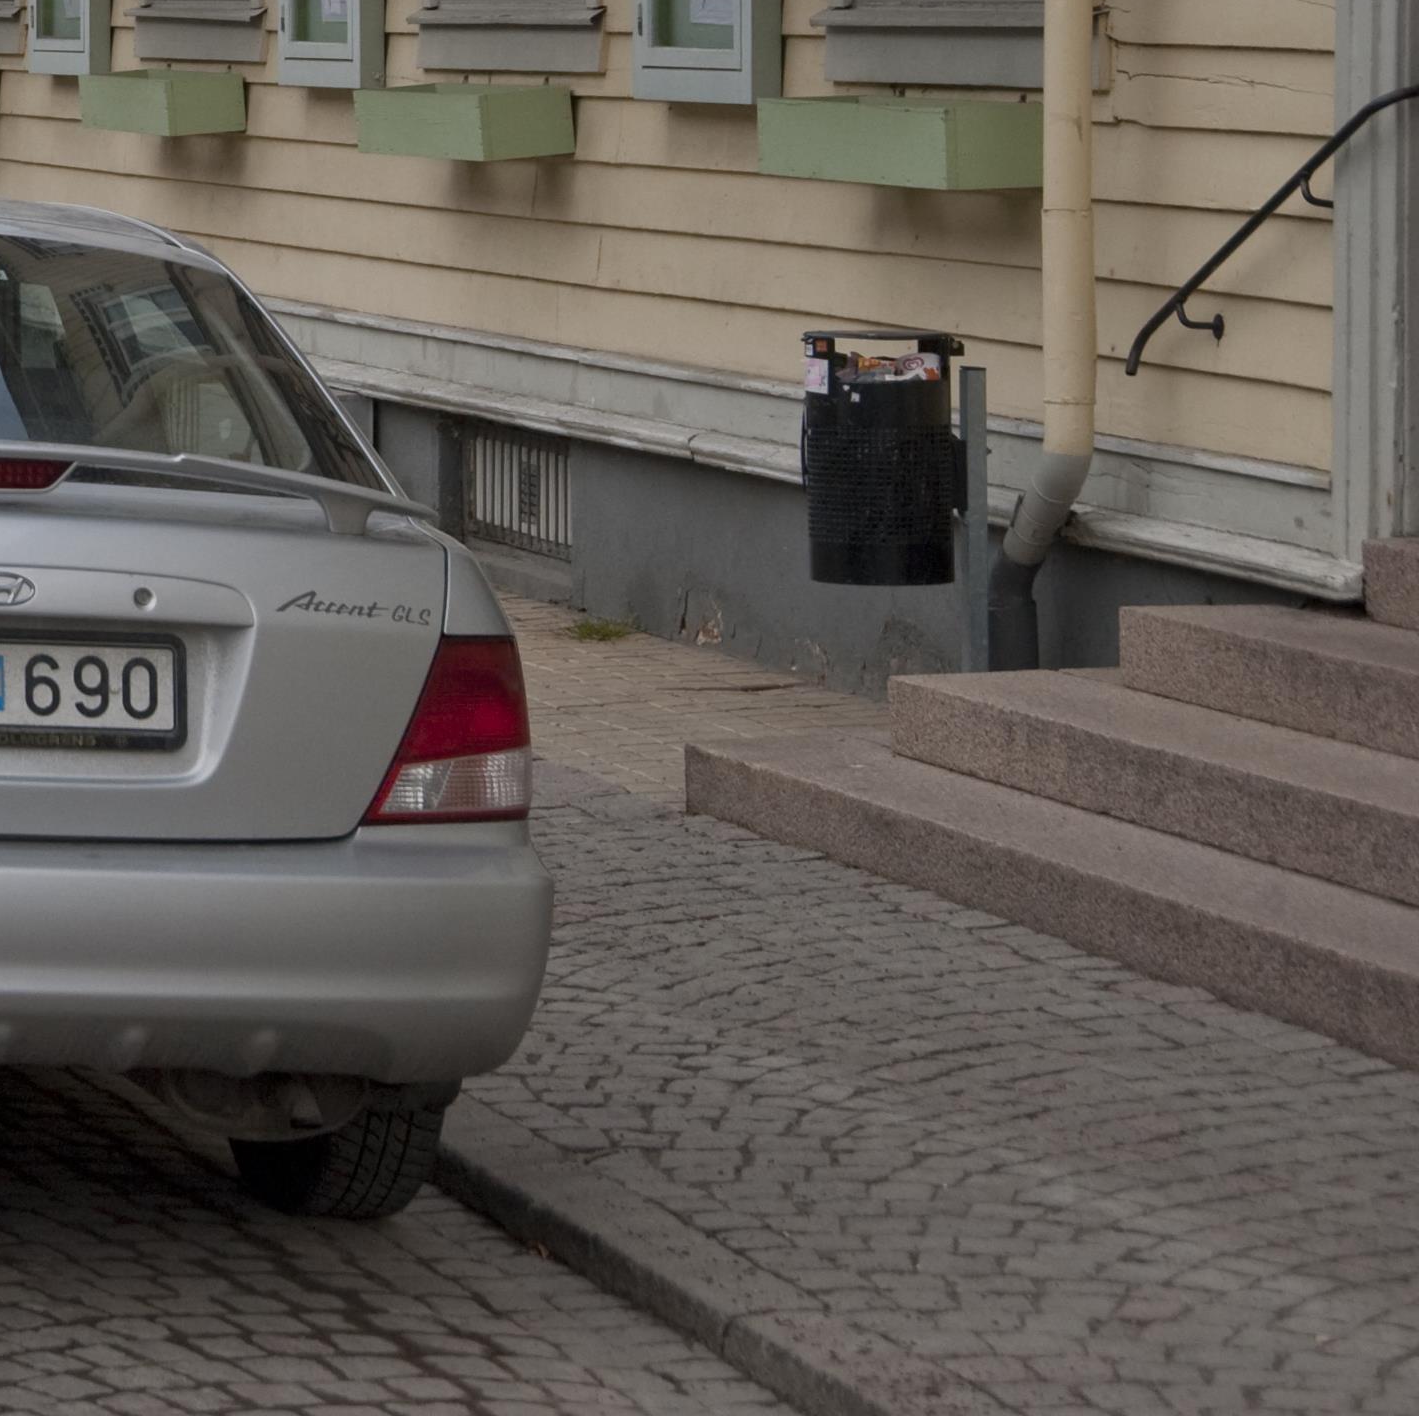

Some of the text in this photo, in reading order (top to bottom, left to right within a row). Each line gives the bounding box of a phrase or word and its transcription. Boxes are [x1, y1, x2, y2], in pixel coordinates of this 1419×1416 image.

[276, 590, 432, 627] Accent GLS
[24, 654, 158, 720] 690
